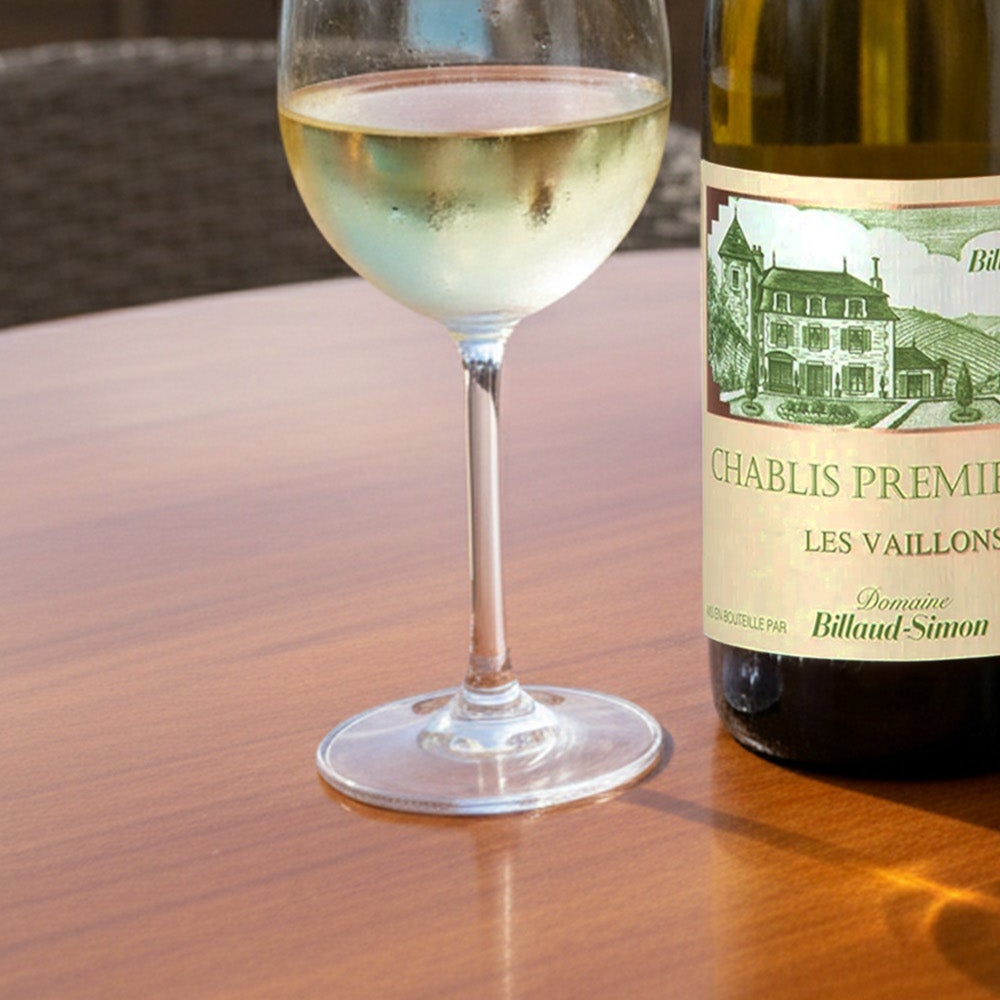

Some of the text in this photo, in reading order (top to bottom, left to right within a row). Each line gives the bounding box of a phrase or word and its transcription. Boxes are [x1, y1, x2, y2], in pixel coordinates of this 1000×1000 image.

[711, 447, 840, 498] CHABLIS
[804, 529, 852, 554] LES
[856, 586, 953, 611] Domaine
[767, 618, 788, 634] PAR
[811, 611, 989, 642] Billaud-Simon
